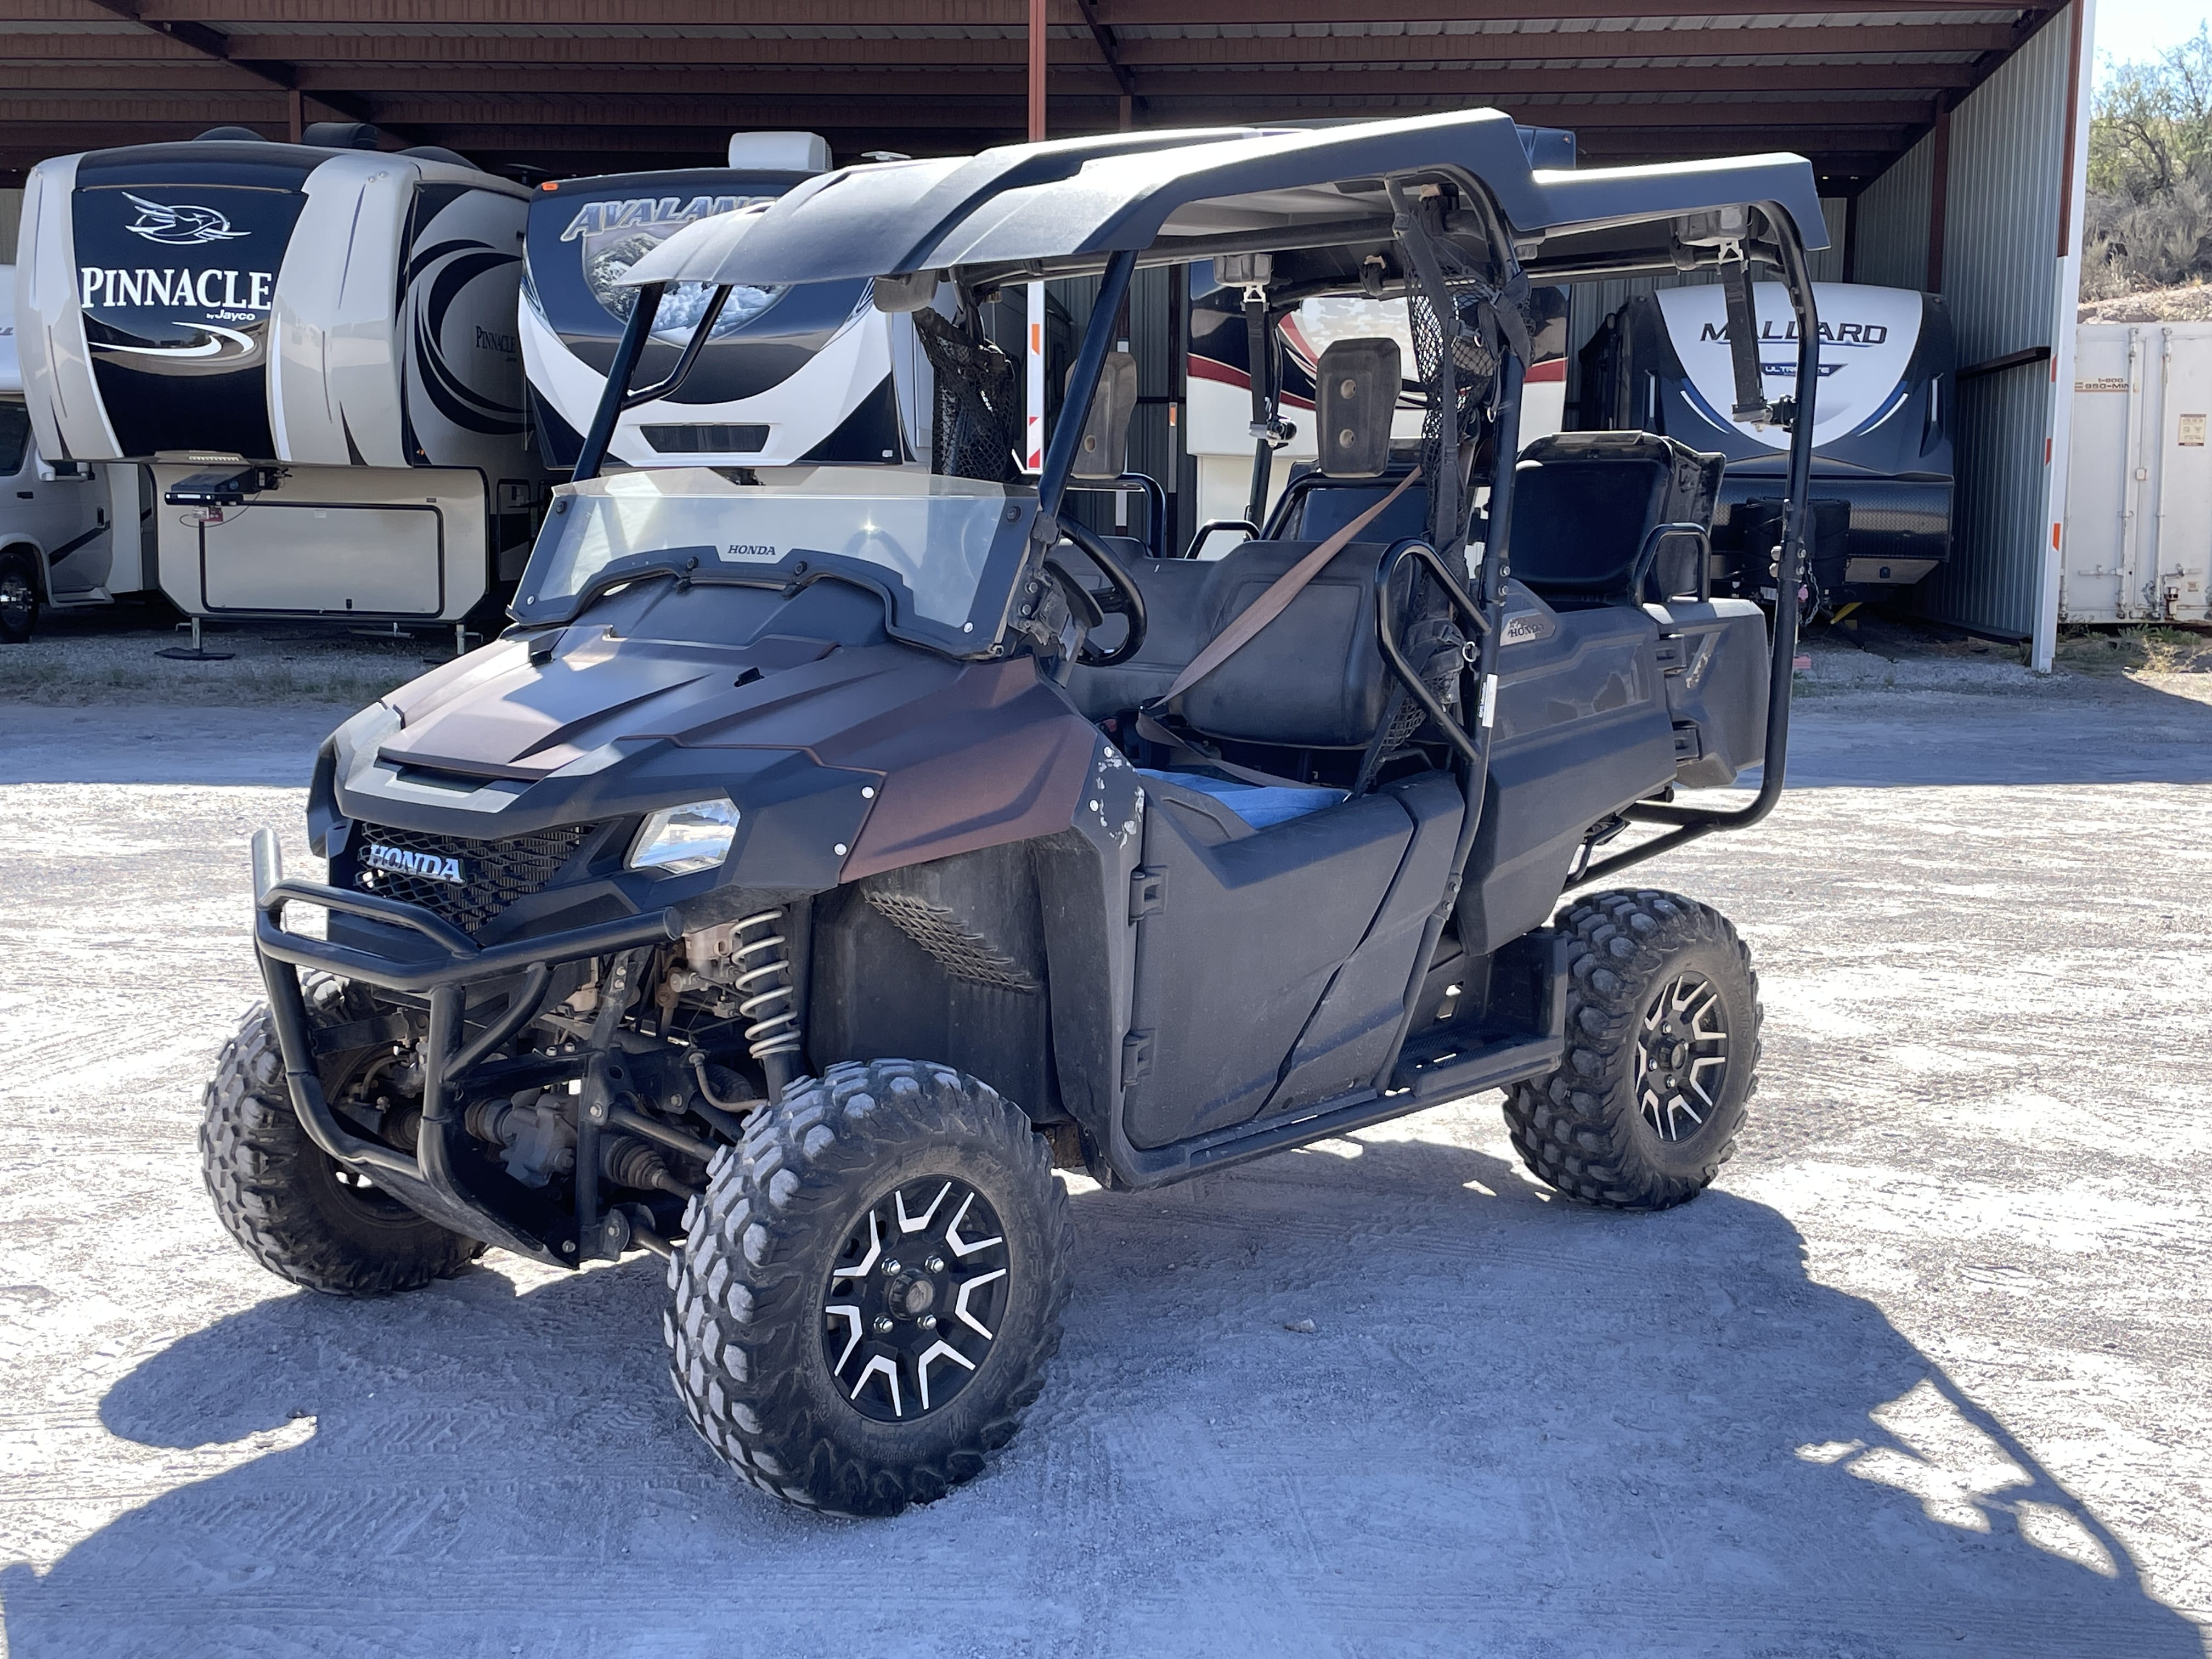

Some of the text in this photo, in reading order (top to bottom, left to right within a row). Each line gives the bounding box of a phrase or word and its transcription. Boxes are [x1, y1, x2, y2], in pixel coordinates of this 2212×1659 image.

[81, 267, 272, 310] PINNACLE
[215, 309, 256, 321] Jayco
[476, 325, 516, 353] PINNACLE
[1700, 321, 1888, 344] MLLARD
[727, 545, 776, 555] HONDA
[366, 844, 465, 883] HONDA
